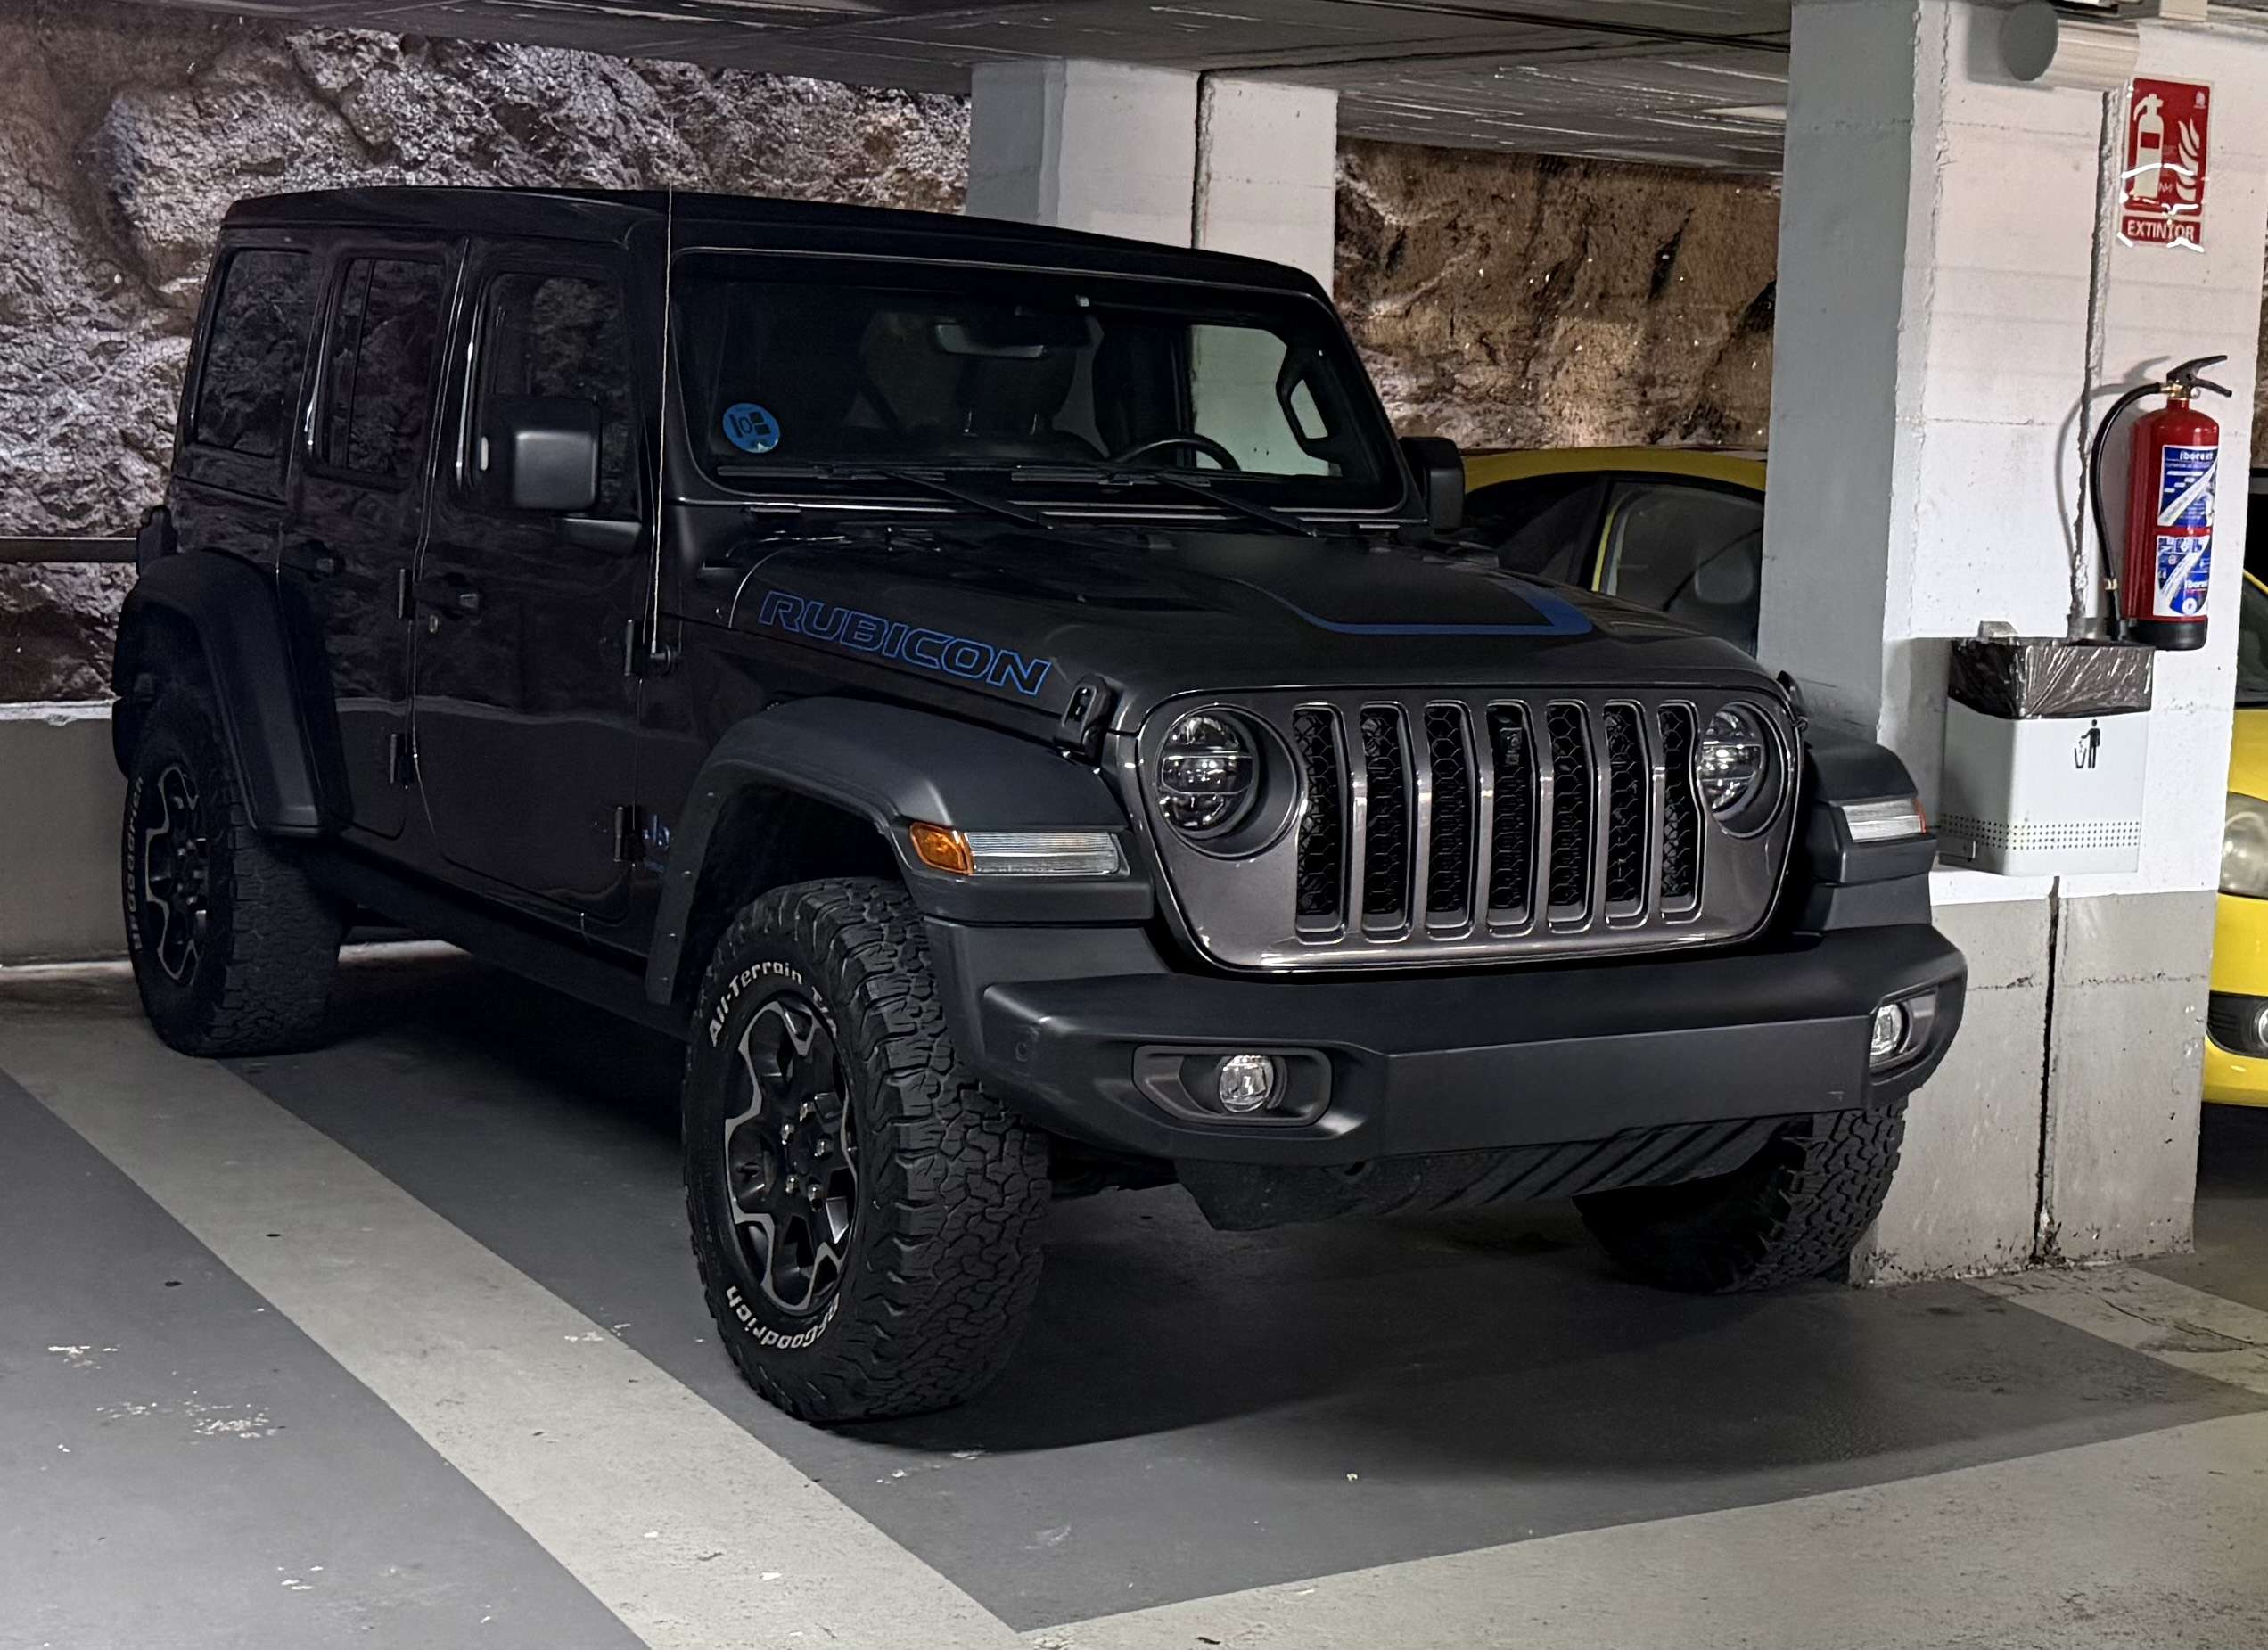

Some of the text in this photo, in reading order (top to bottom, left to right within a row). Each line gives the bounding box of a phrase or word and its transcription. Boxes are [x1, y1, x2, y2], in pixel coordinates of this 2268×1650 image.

[2127, 219, 2195, 242] EXTINTOR
[759, 589, 1052, 697] RUBICON
[709, 961, 802, 1048] All-Terrain
